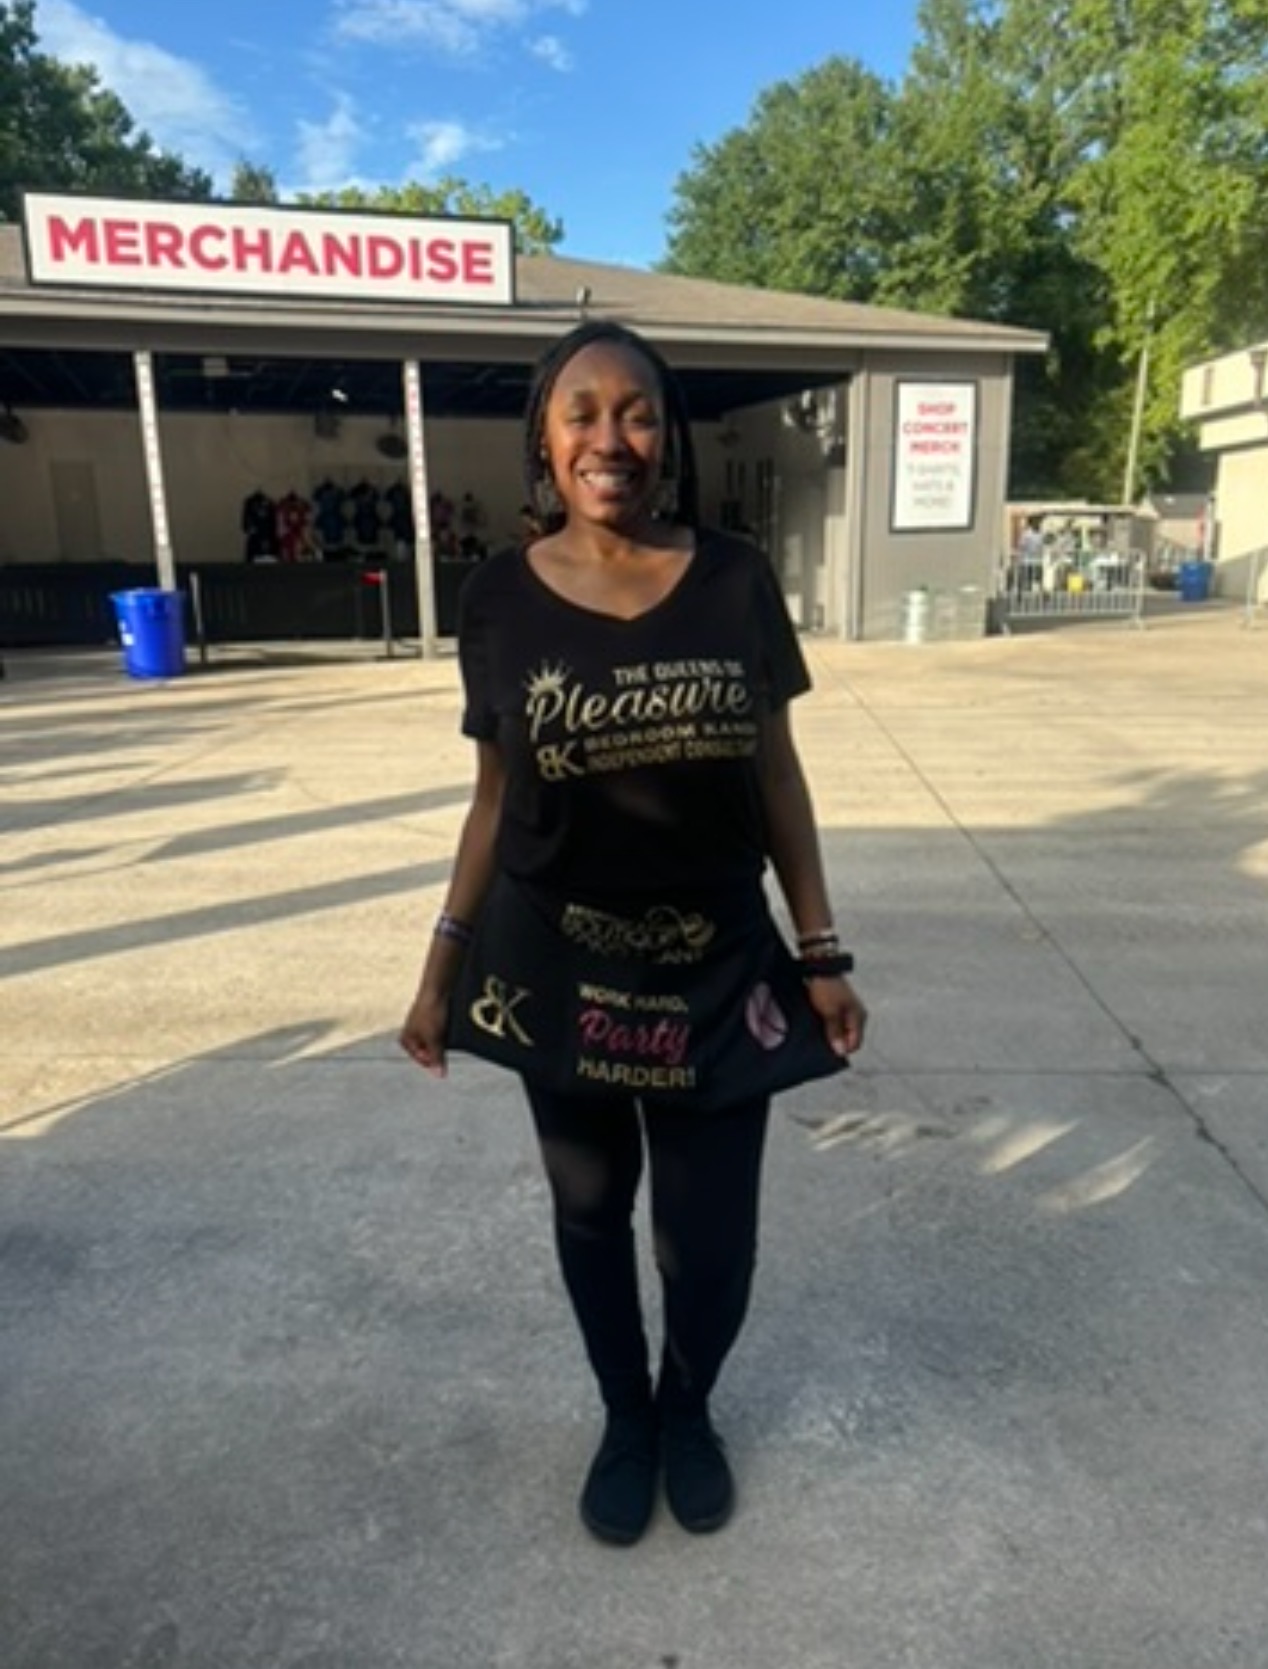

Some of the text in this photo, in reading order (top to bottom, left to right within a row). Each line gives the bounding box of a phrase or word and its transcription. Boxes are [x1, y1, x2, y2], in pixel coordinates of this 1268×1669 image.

[47, 215, 495, 284] MERCHANDISE
[918, 402, 956, 415] SHOP
[903, 421, 968, 434] CONCERT
[910, 441, 960, 454] MERCH
[613, 667, 649, 685] THE
[526, 677, 750, 743] Pleasure
[583, 725, 696, 751] BEDROOM
[578, 983, 632, 1010] WORK
[578, 1009, 692, 1064] Party
[577, 1057, 696, 1089] HARDER!
